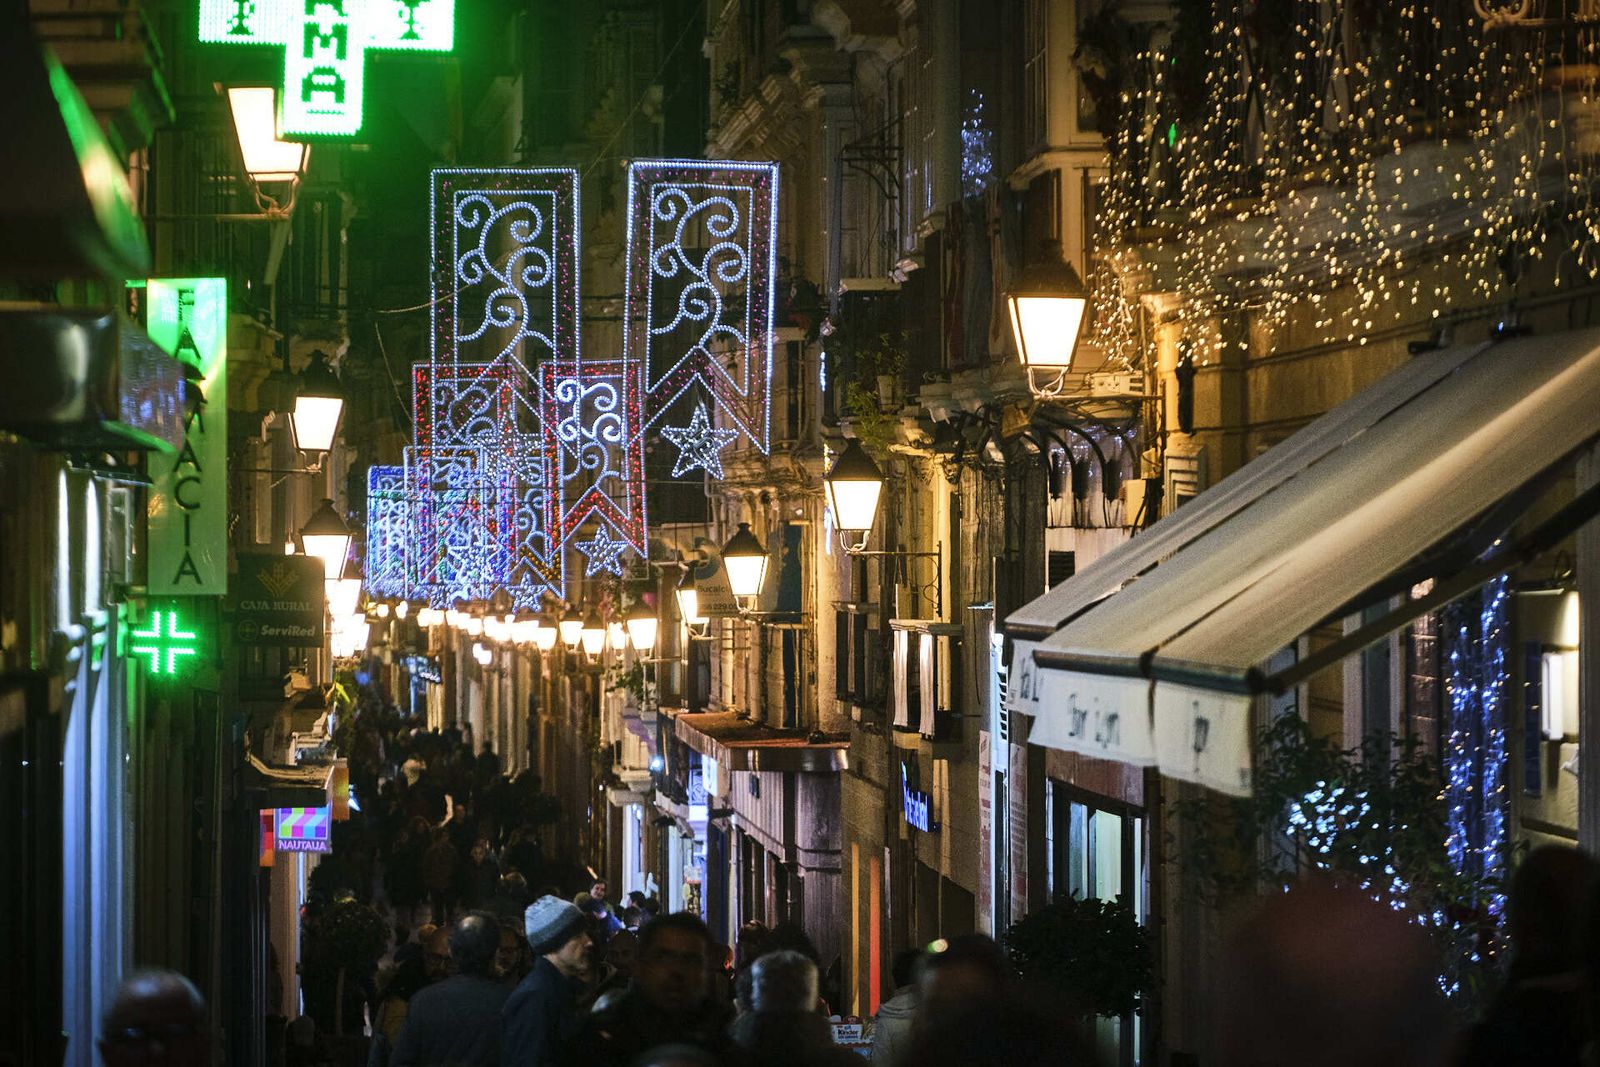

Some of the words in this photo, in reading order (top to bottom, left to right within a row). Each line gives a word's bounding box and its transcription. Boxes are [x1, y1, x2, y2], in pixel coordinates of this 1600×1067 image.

[172, 288, 204, 586] FAMACIA
[240, 600, 269, 611] CAJA
[273, 601, 314, 612] RURAL
[260, 625, 316, 638] ServiRed
